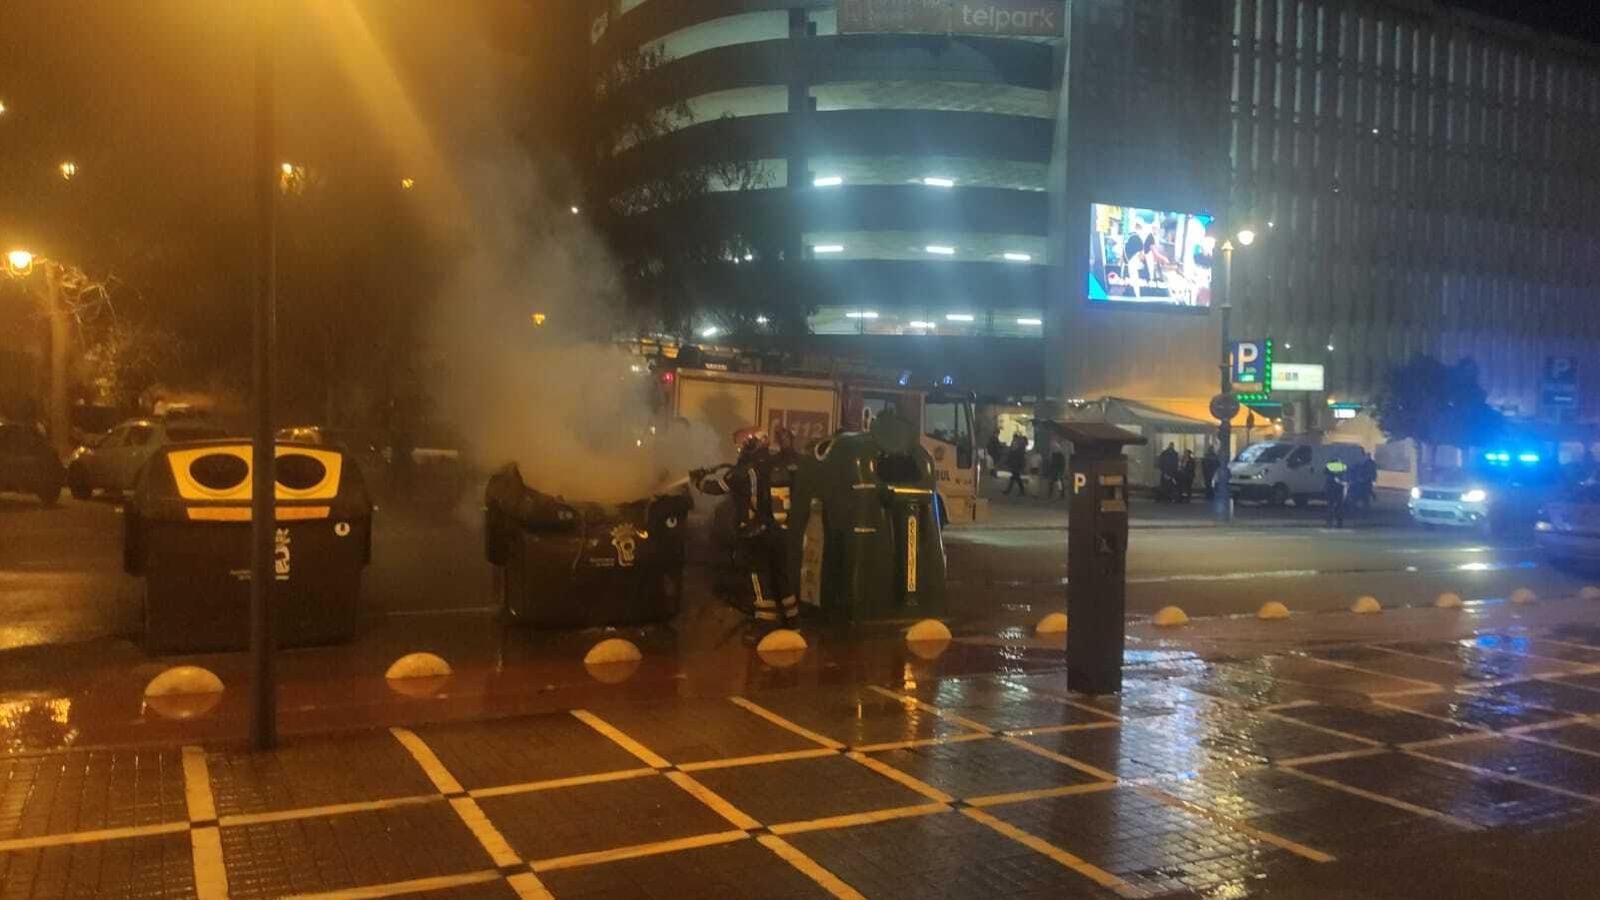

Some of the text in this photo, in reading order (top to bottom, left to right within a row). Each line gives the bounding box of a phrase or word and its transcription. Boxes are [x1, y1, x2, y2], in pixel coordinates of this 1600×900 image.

[961, 4, 1055, 31] telpark
[1238, 342, 1258, 374] P
[1074, 472, 1086, 494] P
